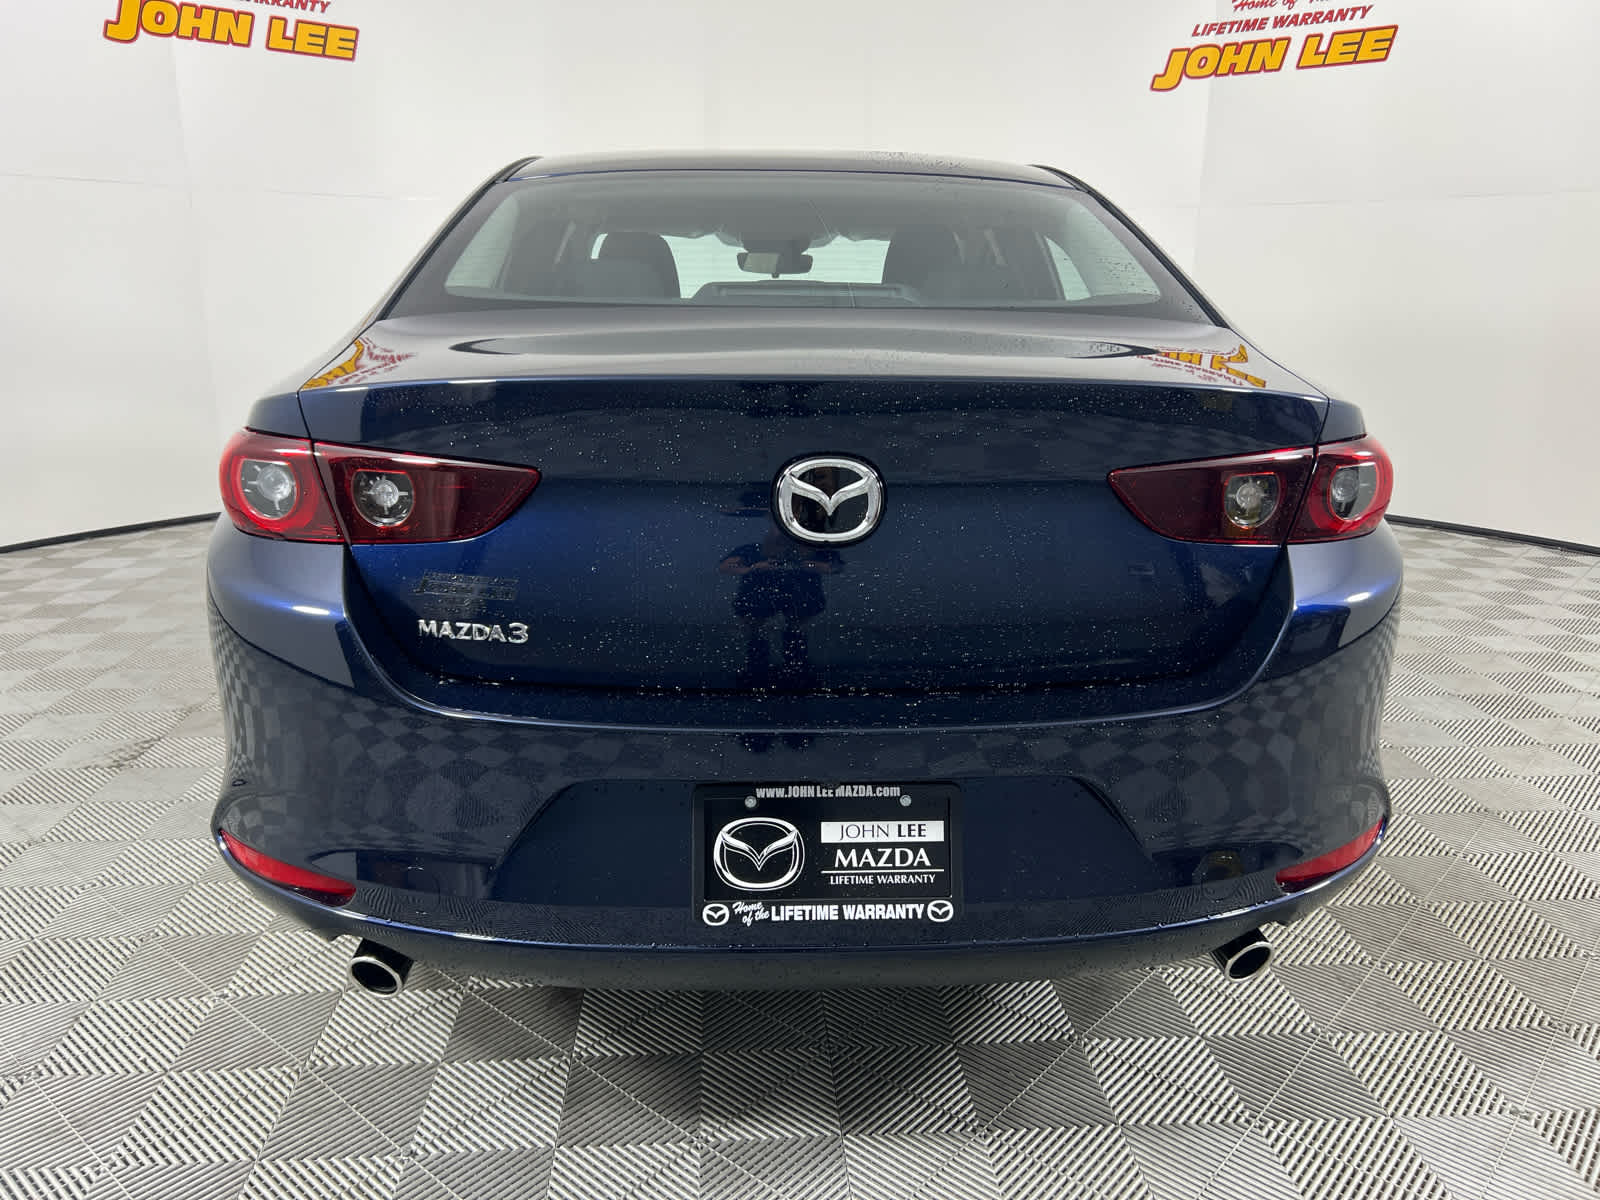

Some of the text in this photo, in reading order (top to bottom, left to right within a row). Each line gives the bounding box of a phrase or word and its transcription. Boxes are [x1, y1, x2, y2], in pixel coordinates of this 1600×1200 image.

[103, 0, 359, 61] JOHN LEE
[1191, 5, 1374, 37] LIFETIME WARRANTY
[1150, 25, 1398, 92] JOHN LEE
[418, 619, 529, 643] MAZDA3
[840, 823, 927, 841] JOHN LEE
[834, 847, 931, 868] MAZDA
[830, 874, 936, 885] LIFETIME WARRANTY
[732, 901, 763, 915] Home
[742, 907, 770, 927] of the
[771, 903, 925, 921] LIFETIME WARRANTY
